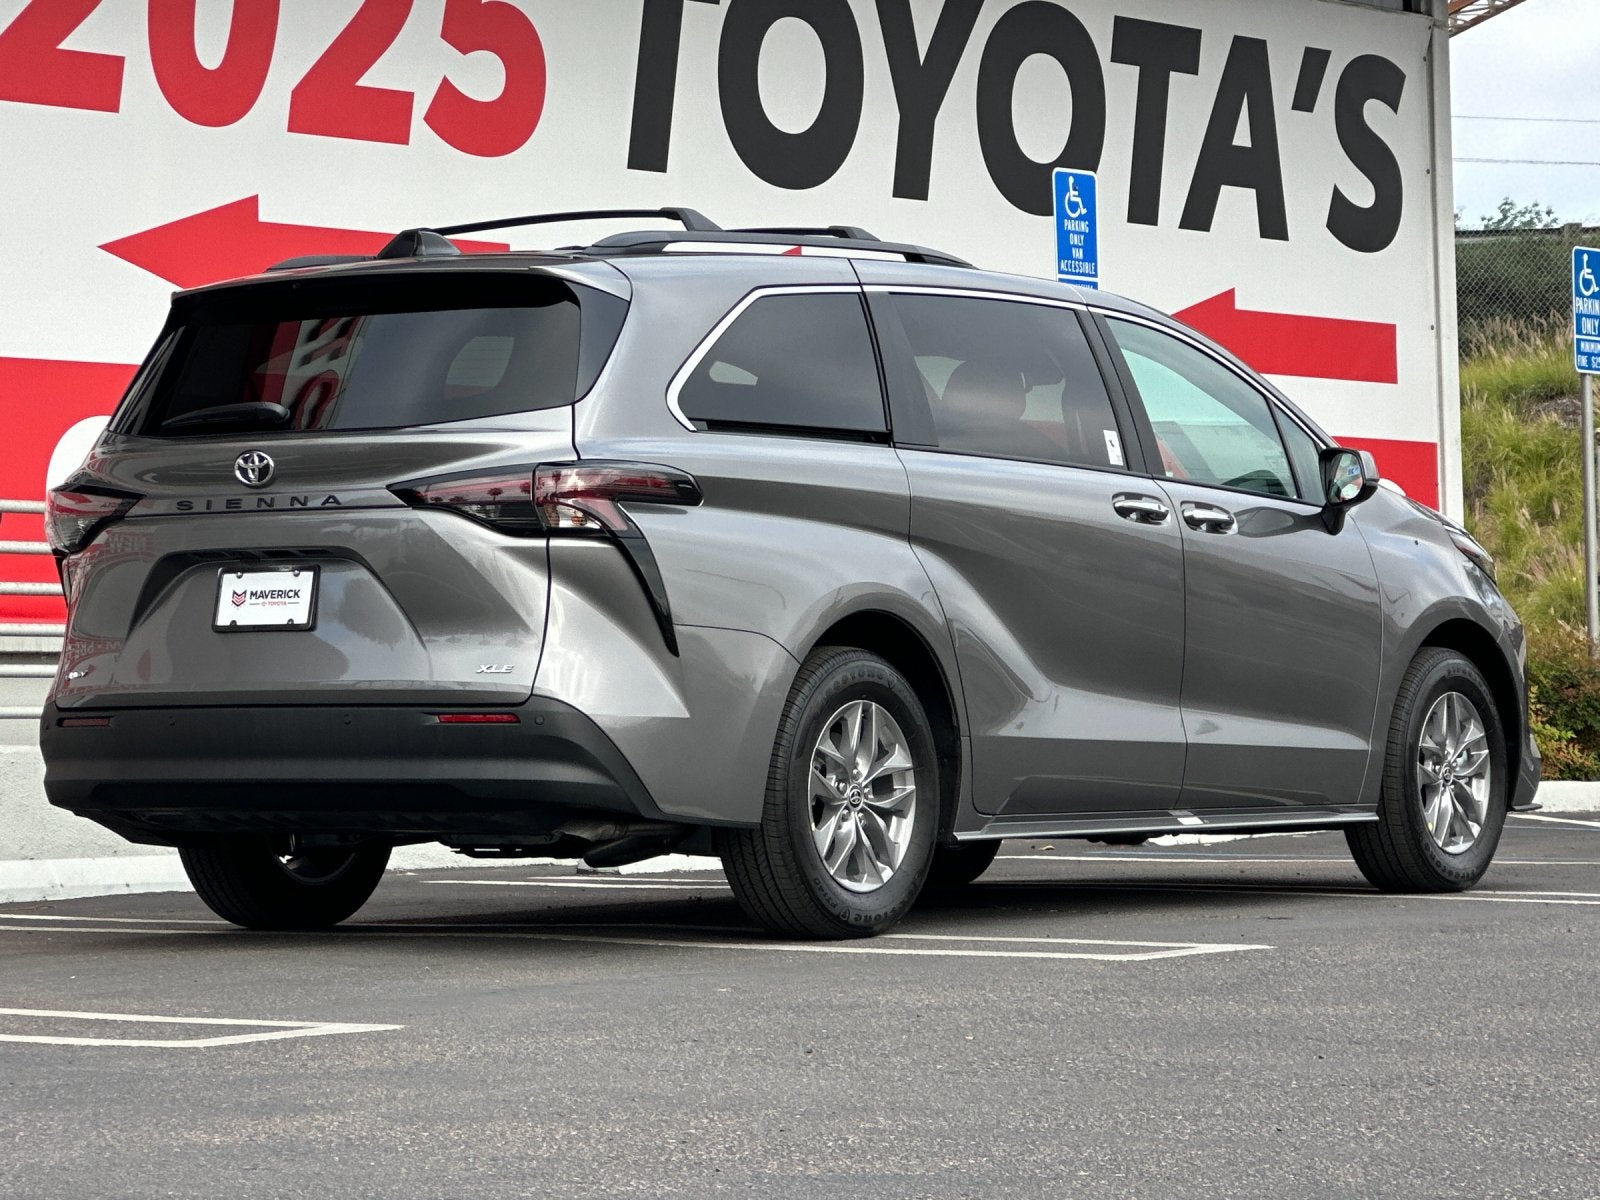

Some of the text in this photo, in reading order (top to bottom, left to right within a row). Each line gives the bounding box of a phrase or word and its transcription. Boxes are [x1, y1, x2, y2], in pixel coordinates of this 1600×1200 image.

[626, 0, 1407, 253] TOYOTA'S
[1064, 218, 1089, 233] PARKING
[1069, 233, 1085, 246] ONLY
[1072, 247, 1083, 260] VAN
[1060, 260, 1096, 275] ACCESSIBLE
[1575, 296, 1600, 315] PARKIN
[1581, 317, 1599, 335] ONLY
[176, 495, 342, 511] SIENNA
[249, 589, 301, 600] MAVERICK
[475, 664, 514, 673] XLE
